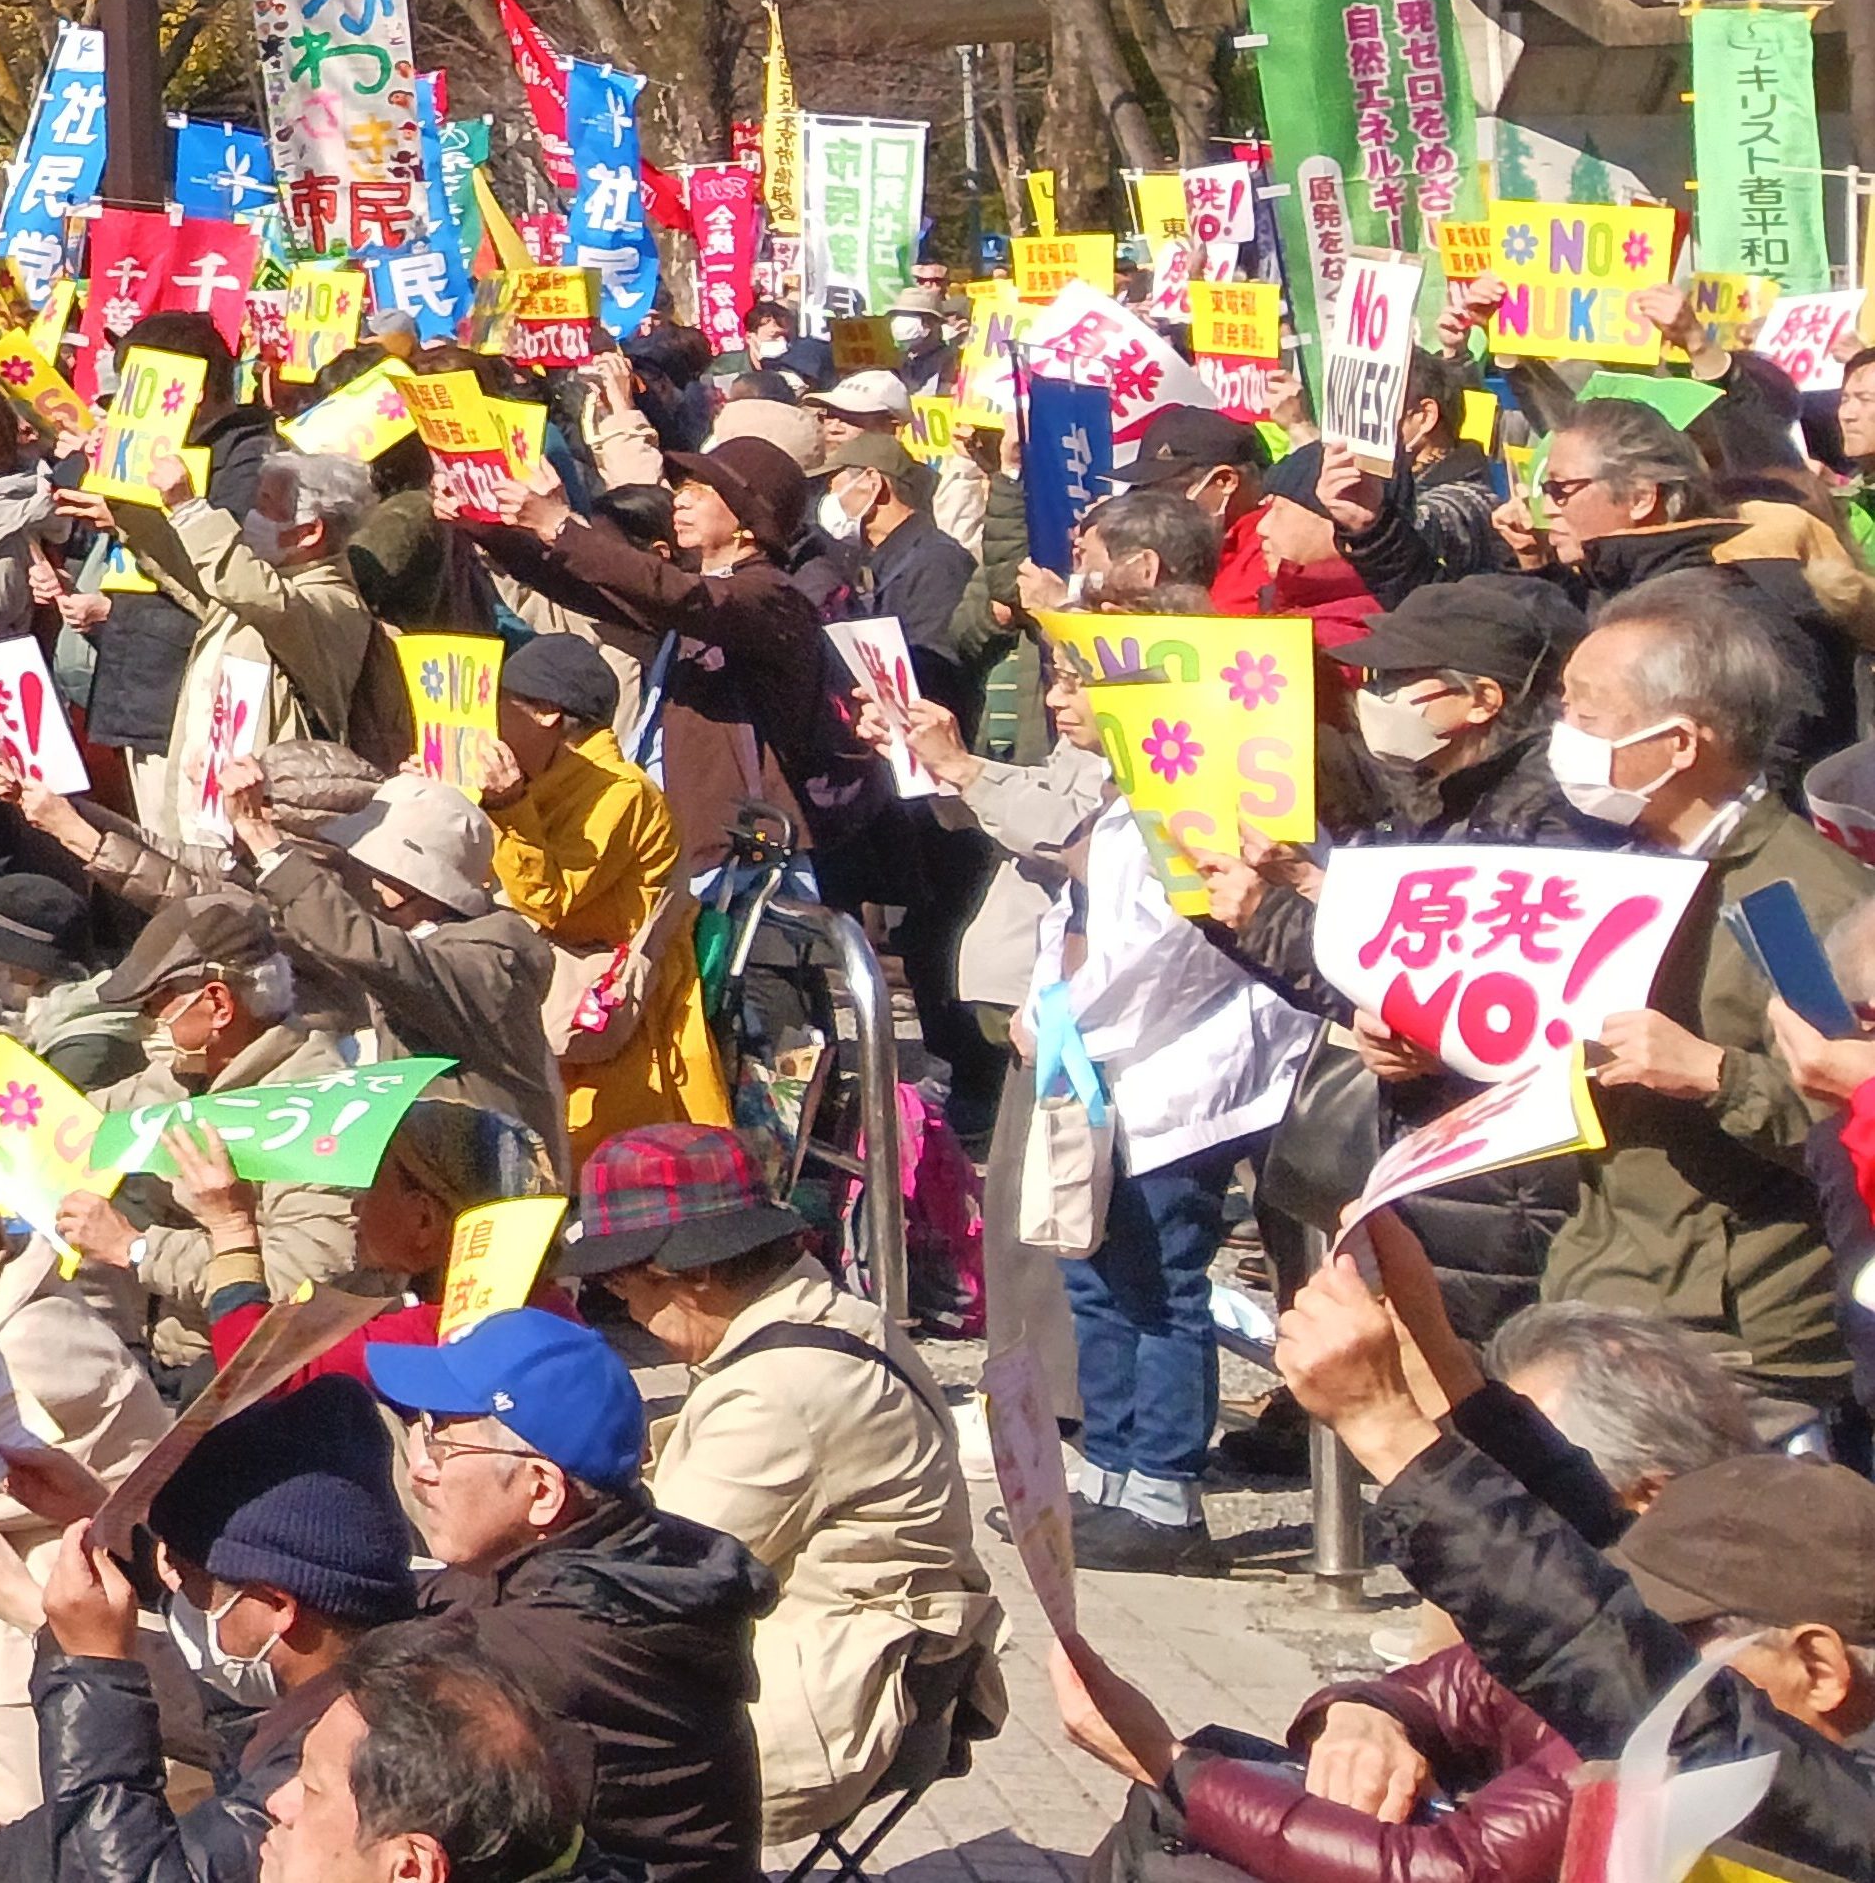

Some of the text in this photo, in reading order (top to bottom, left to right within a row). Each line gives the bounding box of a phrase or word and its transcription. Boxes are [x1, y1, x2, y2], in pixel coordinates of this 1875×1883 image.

[1343, 4, 1407, 249] 自然エネルギー
[9, 82, 106, 306] 社民党
[289, 168, 413, 255] 市民
[1549, 218, 1615, 277] NO
[1498, 283, 1653, 347] NUKES
[118, 365, 158, 419] NO
[1326, 353, 1402, 447] NUKES!
[448, 651, 476, 714] NO
[1358, 864, 1587, 971] 原発
[1379, 894, 1664, 1066] NO!
